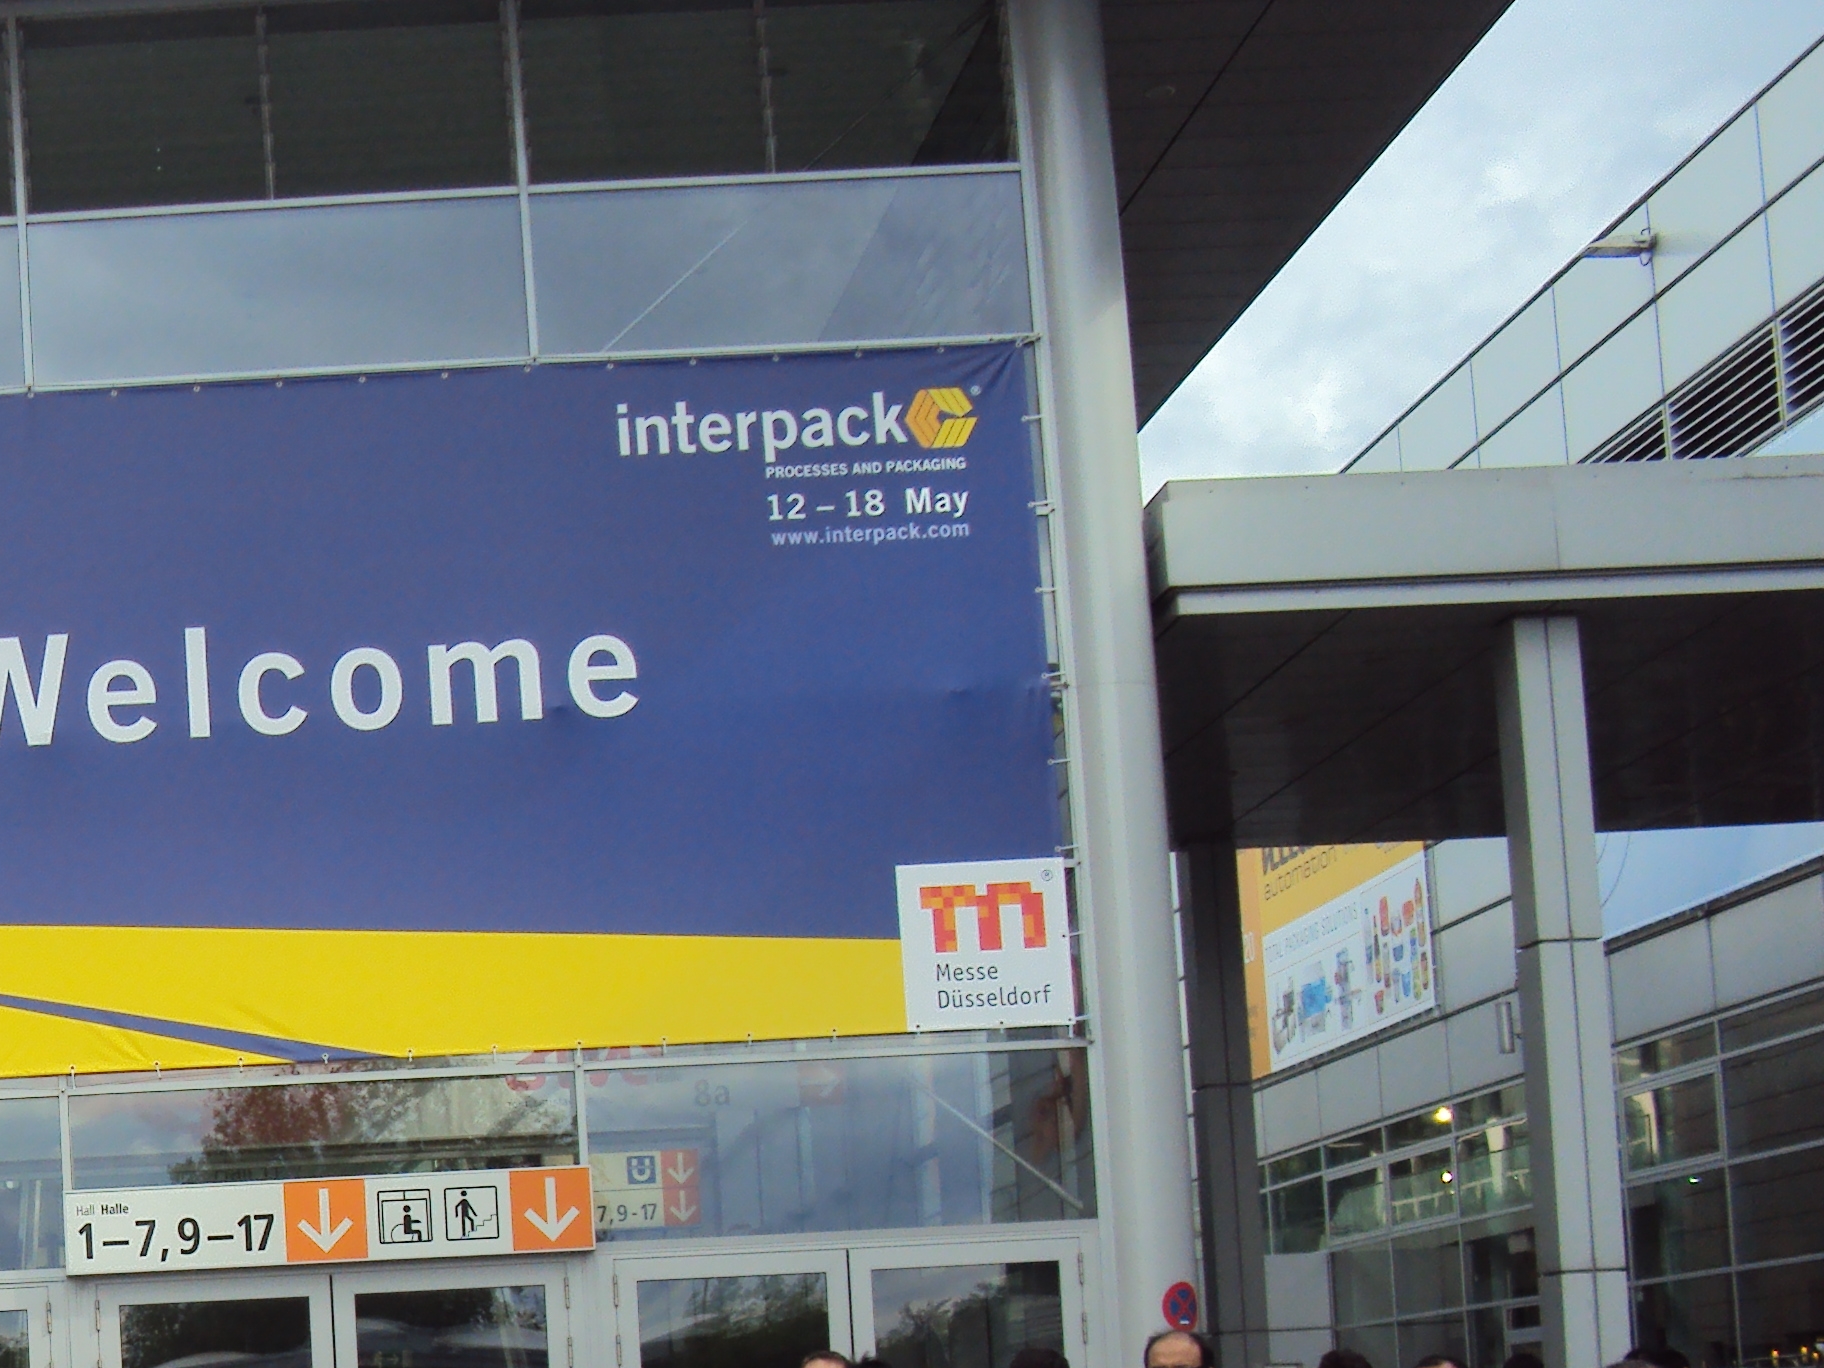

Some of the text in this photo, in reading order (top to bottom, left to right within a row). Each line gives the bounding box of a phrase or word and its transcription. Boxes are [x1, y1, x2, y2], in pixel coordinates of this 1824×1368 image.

[616, 391, 908, 463] interpack
[766, 457, 966, 479] PROCESSES AND PACKAGING
[768, 494, 806, 521] 12
[845, 489, 885, 517] 18
[905, 487, 969, 518] May
[771, 522, 970, 546] www.interpack.com
[1264, 846, 1338, 901] automation
[935, 963, 999, 982] Messe
[937, 984, 1052, 1009] Düsseldorf
[695, 1079, 730, 1107] 8a
[76, 1203, 129, 1216] Hall Halle
